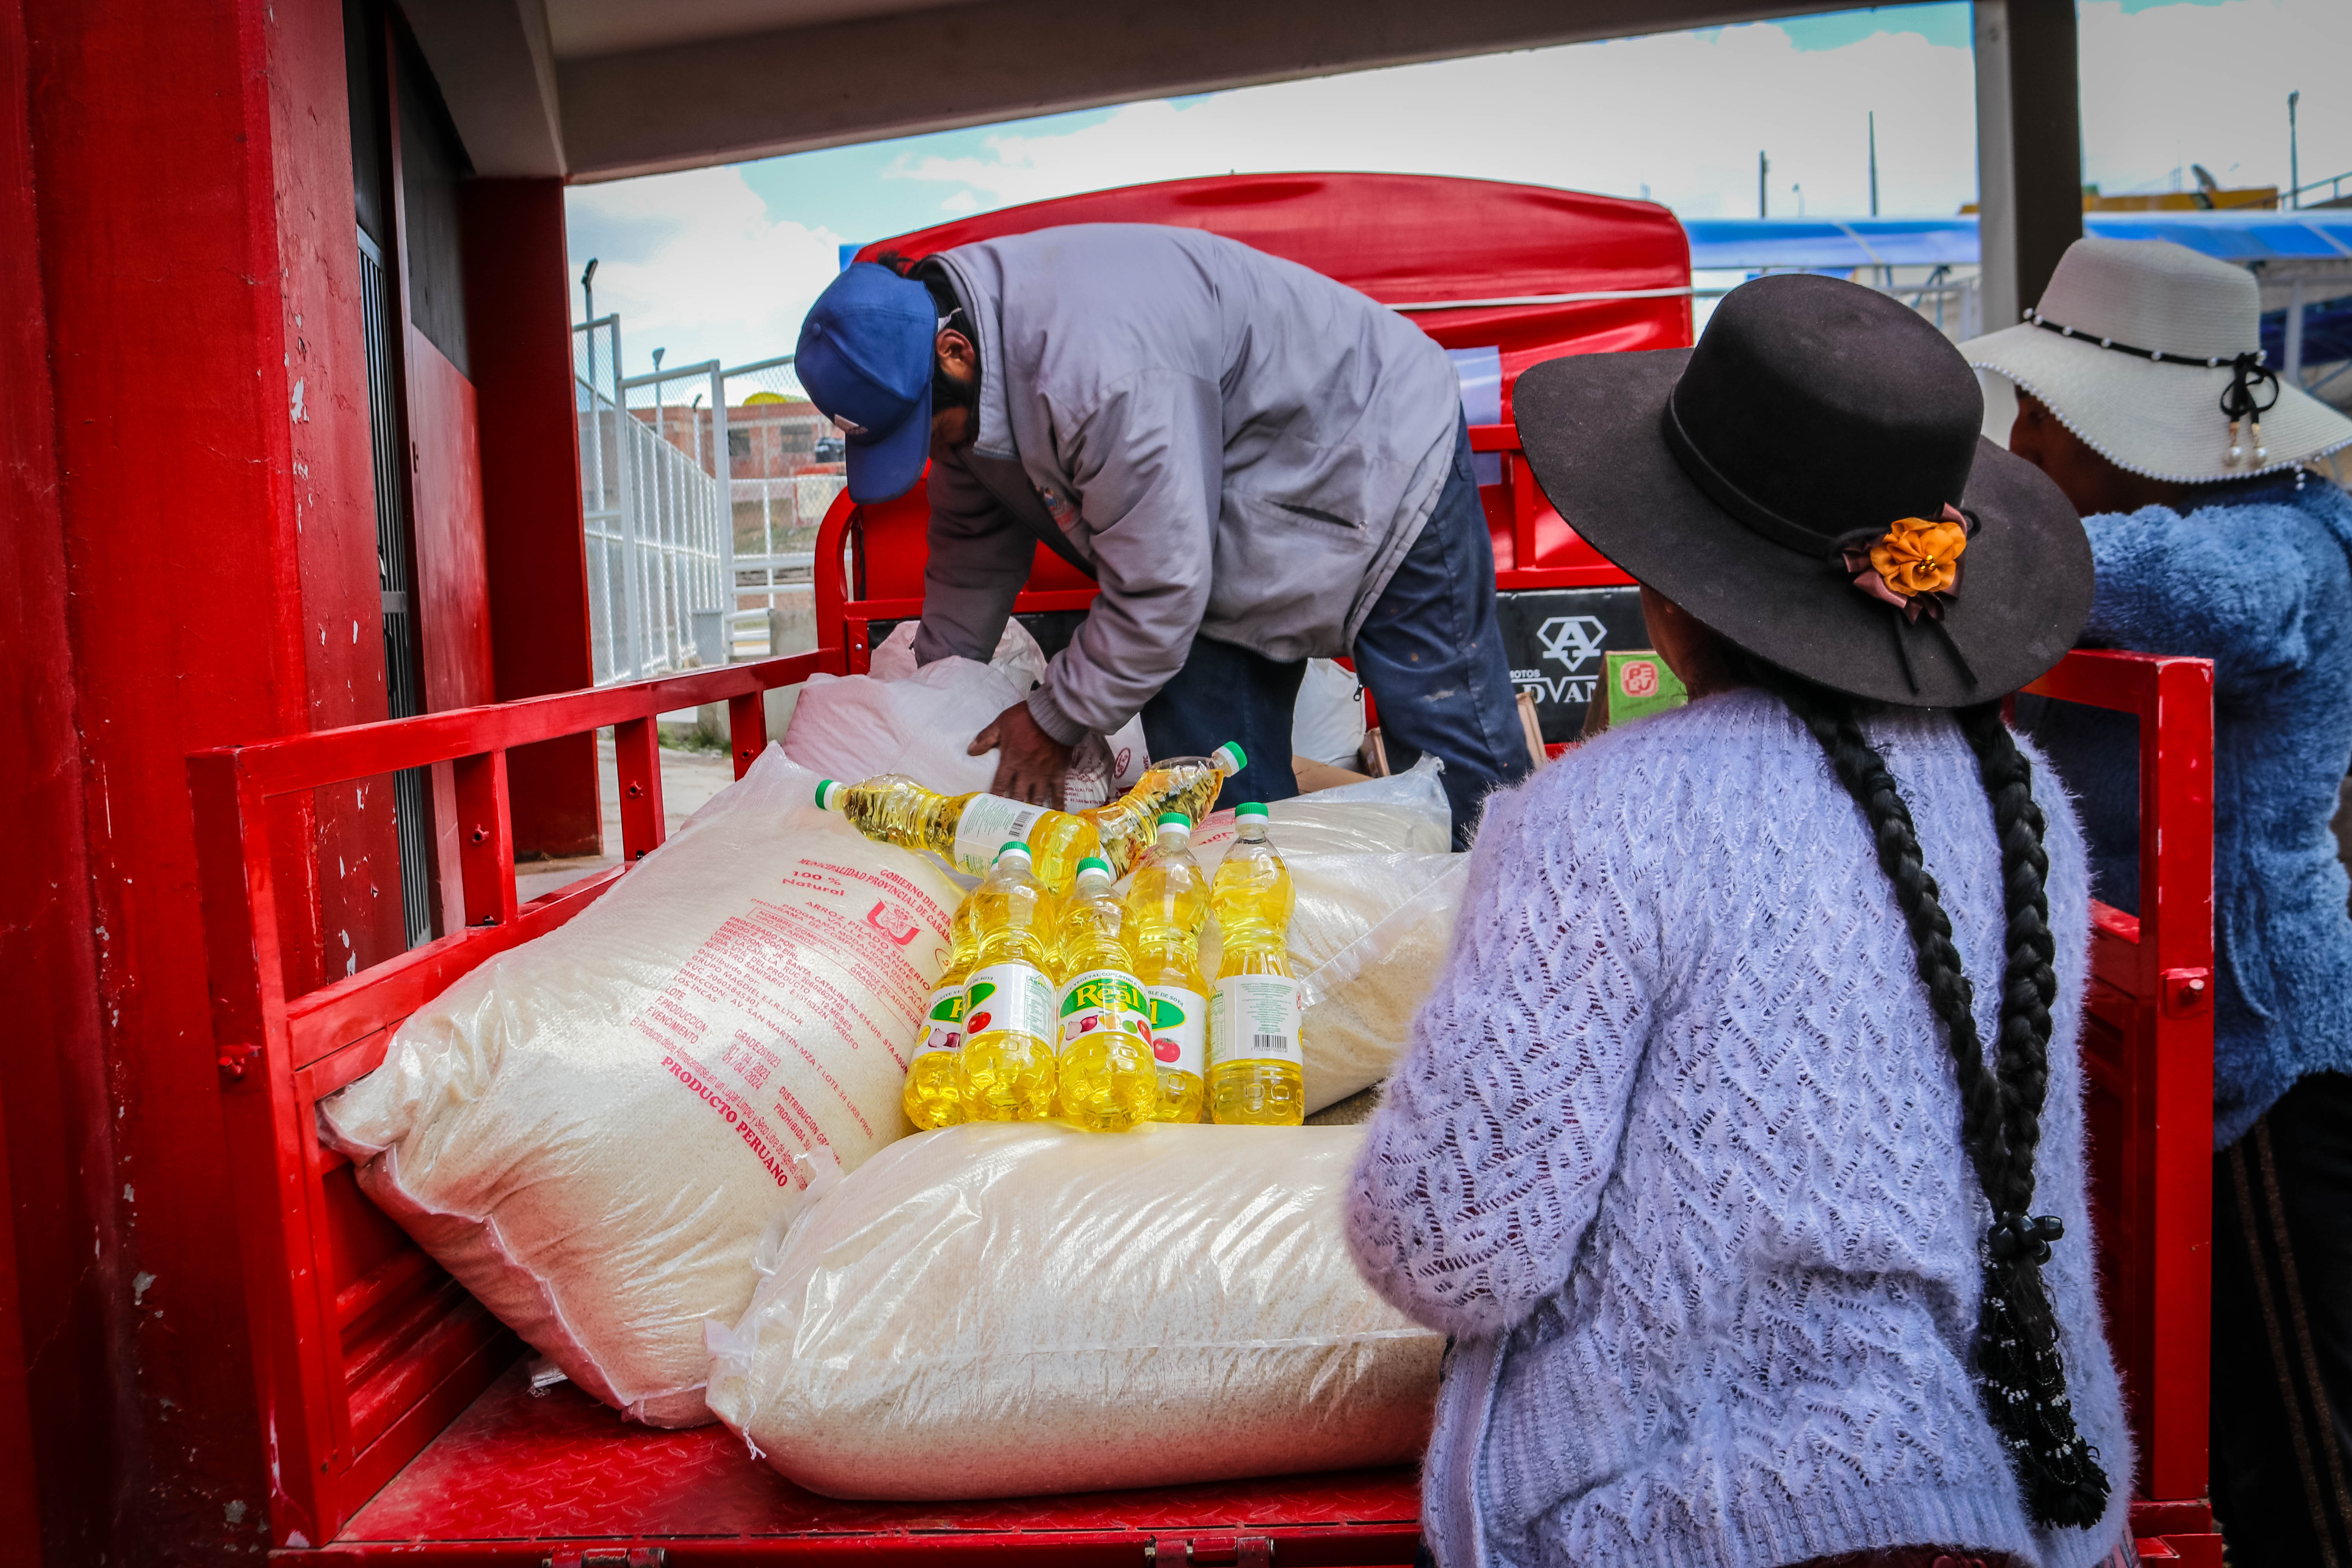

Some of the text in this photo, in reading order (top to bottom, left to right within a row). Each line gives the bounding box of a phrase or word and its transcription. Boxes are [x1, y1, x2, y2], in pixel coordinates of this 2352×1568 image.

[782, 878, 845, 897] Natural
[793, 871, 842, 886] 100 %
[798, 858, 867, 880] MUNICIPALIDAD
[866, 874, 915, 908] PROVINCIAL
[915, 904, 926, 918] DE
[880, 869, 924, 898] GOBIERNO
[922, 896, 938, 911] DEL
[729, 916, 778, 940] PROCESADO
[750, 898, 804, 922] PROGRAMA
[808, 921, 822, 930] DE
[823, 928, 908, 995] COMPLEMENTACION
[805, 901, 846, 922] ARROZ
[848, 920, 889, 949] PILADO
[686, 961, 705, 974] RUC
[697, 948, 742, 976] Distribuido
[703, 941, 744, 964] REGISTRO
[744, 961, 786, 989] SANITARIO
[734, 939, 745, 947] LA
[746, 944, 778, 967] CAPILLA
[783, 965, 801, 979] RUC
[756, 914, 774, 926] TIPO
[774, 922, 788, 931] DE
[787, 929, 816, 947] ARROZ
[850, 966, 877, 990] GRADO
[759, 935, 782, 951] FOOD
[781, 947, 800, 962] EIRL
[759, 910, 795, 929] NOMBRE
[795, 927, 842, 955] COMERCIAL
[854, 962, 882, 985] ARROZ
[881, 984, 906, 1011] PILADO
[782, 904, 835, 932] PROGRAMA
[838, 930, 890, 969] MODALIDAD
[891, 969, 907, 985] DEL
[907, 985, 923, 1002] PCA
[827, 916, 913, 982] VALLE GRANDE
[665, 985, 686, 1001] LOTE
[673, 974, 718, 1003] LOS INCAS
[691, 955, 722, 973] GRUPO
[723, 971, 760, 998] MAGDIEL
[709, 935, 853, 1031] VIDA UTIL DEL PRODUCTO 12 MESES
[1076, 983, 1140, 1013] Real
[786, 958, 812, 978] SANTA
[814, 976, 849, 1005] CATALINA
[849, 1003, 859, 1014] No
[858, 1012, 871, 1026] 614
[870, 1024, 882, 1040] Urb.
[882, 1038, 895, 1054] STA
[1169, 995, 1183, 1007] SOYA
[730, 998, 744, 1011] AV.
[746, 1007, 765, 1022] SAN
[766, 1020, 800, 1048] MARTIN
[799, 1046, 816, 1067] MZA
[817, 1063, 823, 1072] T
[821, 1070, 839, 1092] LOTE
[838, 1090, 848, 1102] 34
[629, 1016, 641, 1027] El
[638, 1020, 664, 1043] Producto
[661, 1037, 677, 1053] debe
[675, 1045, 710, 1079] Almacenarse
[707, 1074, 718, 1085] en
[715, 1079, 725, 1091] un
[722, 1083, 740, 1103] Lugar
[736, 1096, 755, 1119] Limpio
[749, 1114, 759, 1125] y
[755, 1116, 770, 1135] Seco
[766, 1128, 780, 1148] Libre
[775, 1142, 786, 1155] de
[661, 1055, 788, 1187] PRODUCTO PERUANO
[774, 1103, 806, 1142] PROHIBIDA
[779, 1086, 820, 1135] DISTRIBUCION
